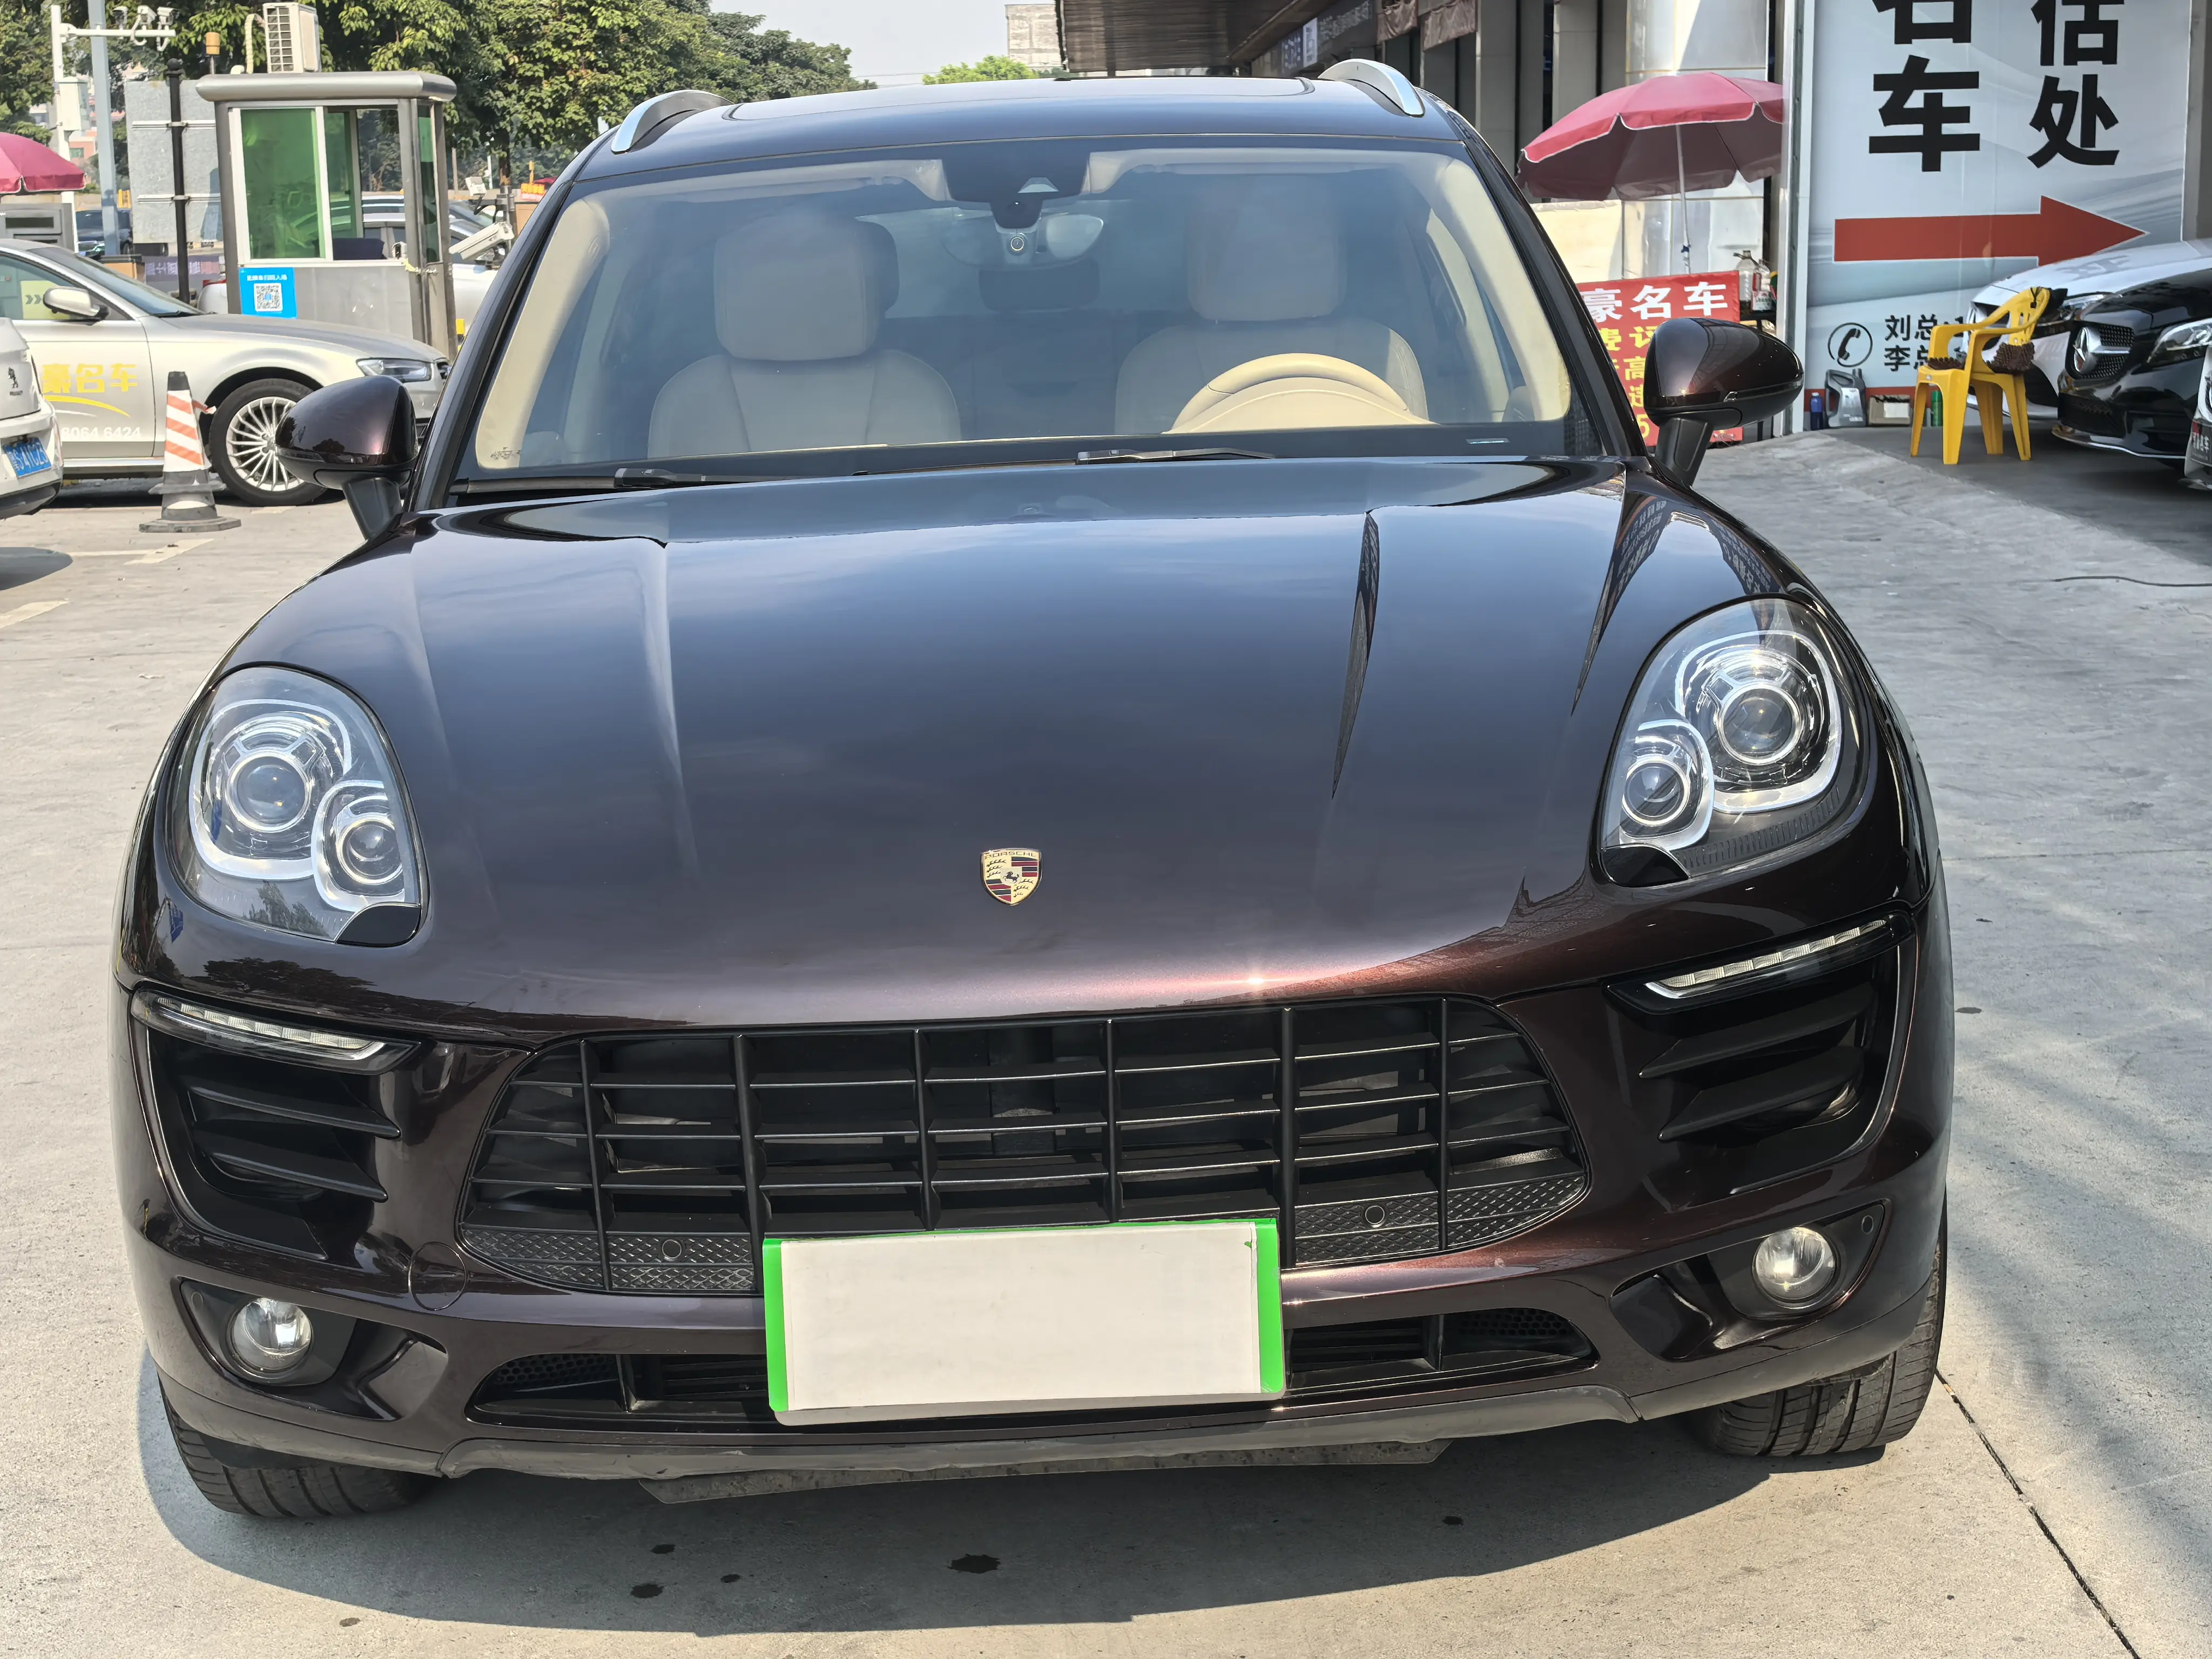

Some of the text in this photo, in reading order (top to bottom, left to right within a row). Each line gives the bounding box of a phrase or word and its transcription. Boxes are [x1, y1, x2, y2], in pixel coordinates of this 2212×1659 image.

[42, 363, 138, 393] 豪名车
[103, 427, 141, 439] 6424
